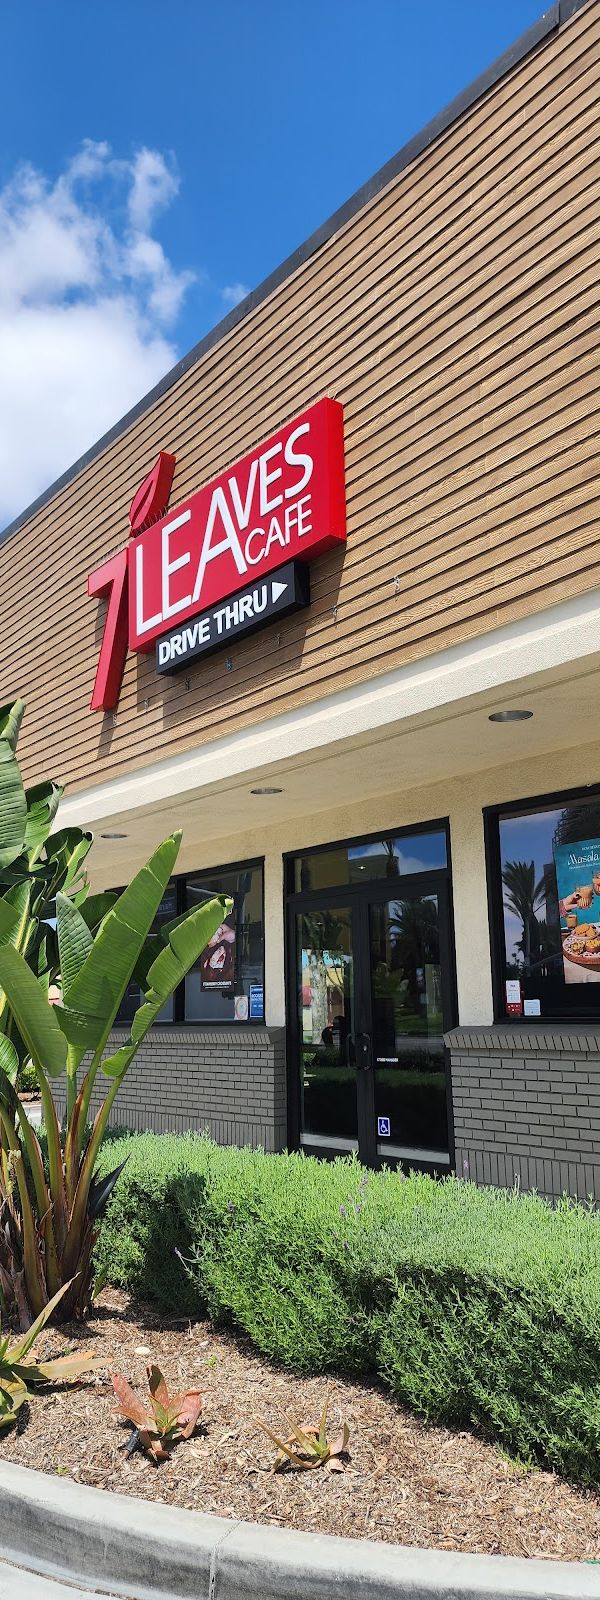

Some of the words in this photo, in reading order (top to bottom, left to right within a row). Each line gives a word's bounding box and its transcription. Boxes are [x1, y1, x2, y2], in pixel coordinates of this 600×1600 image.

[87, 546, 130, 712] 7
[135, 422, 314, 637] LEAVES
[244, 494, 313, 566] CAFE
[158, 617, 211, 665] DRIVE
[213, 584, 268, 635] THRU
[567, 850, 599, 866] Masala
